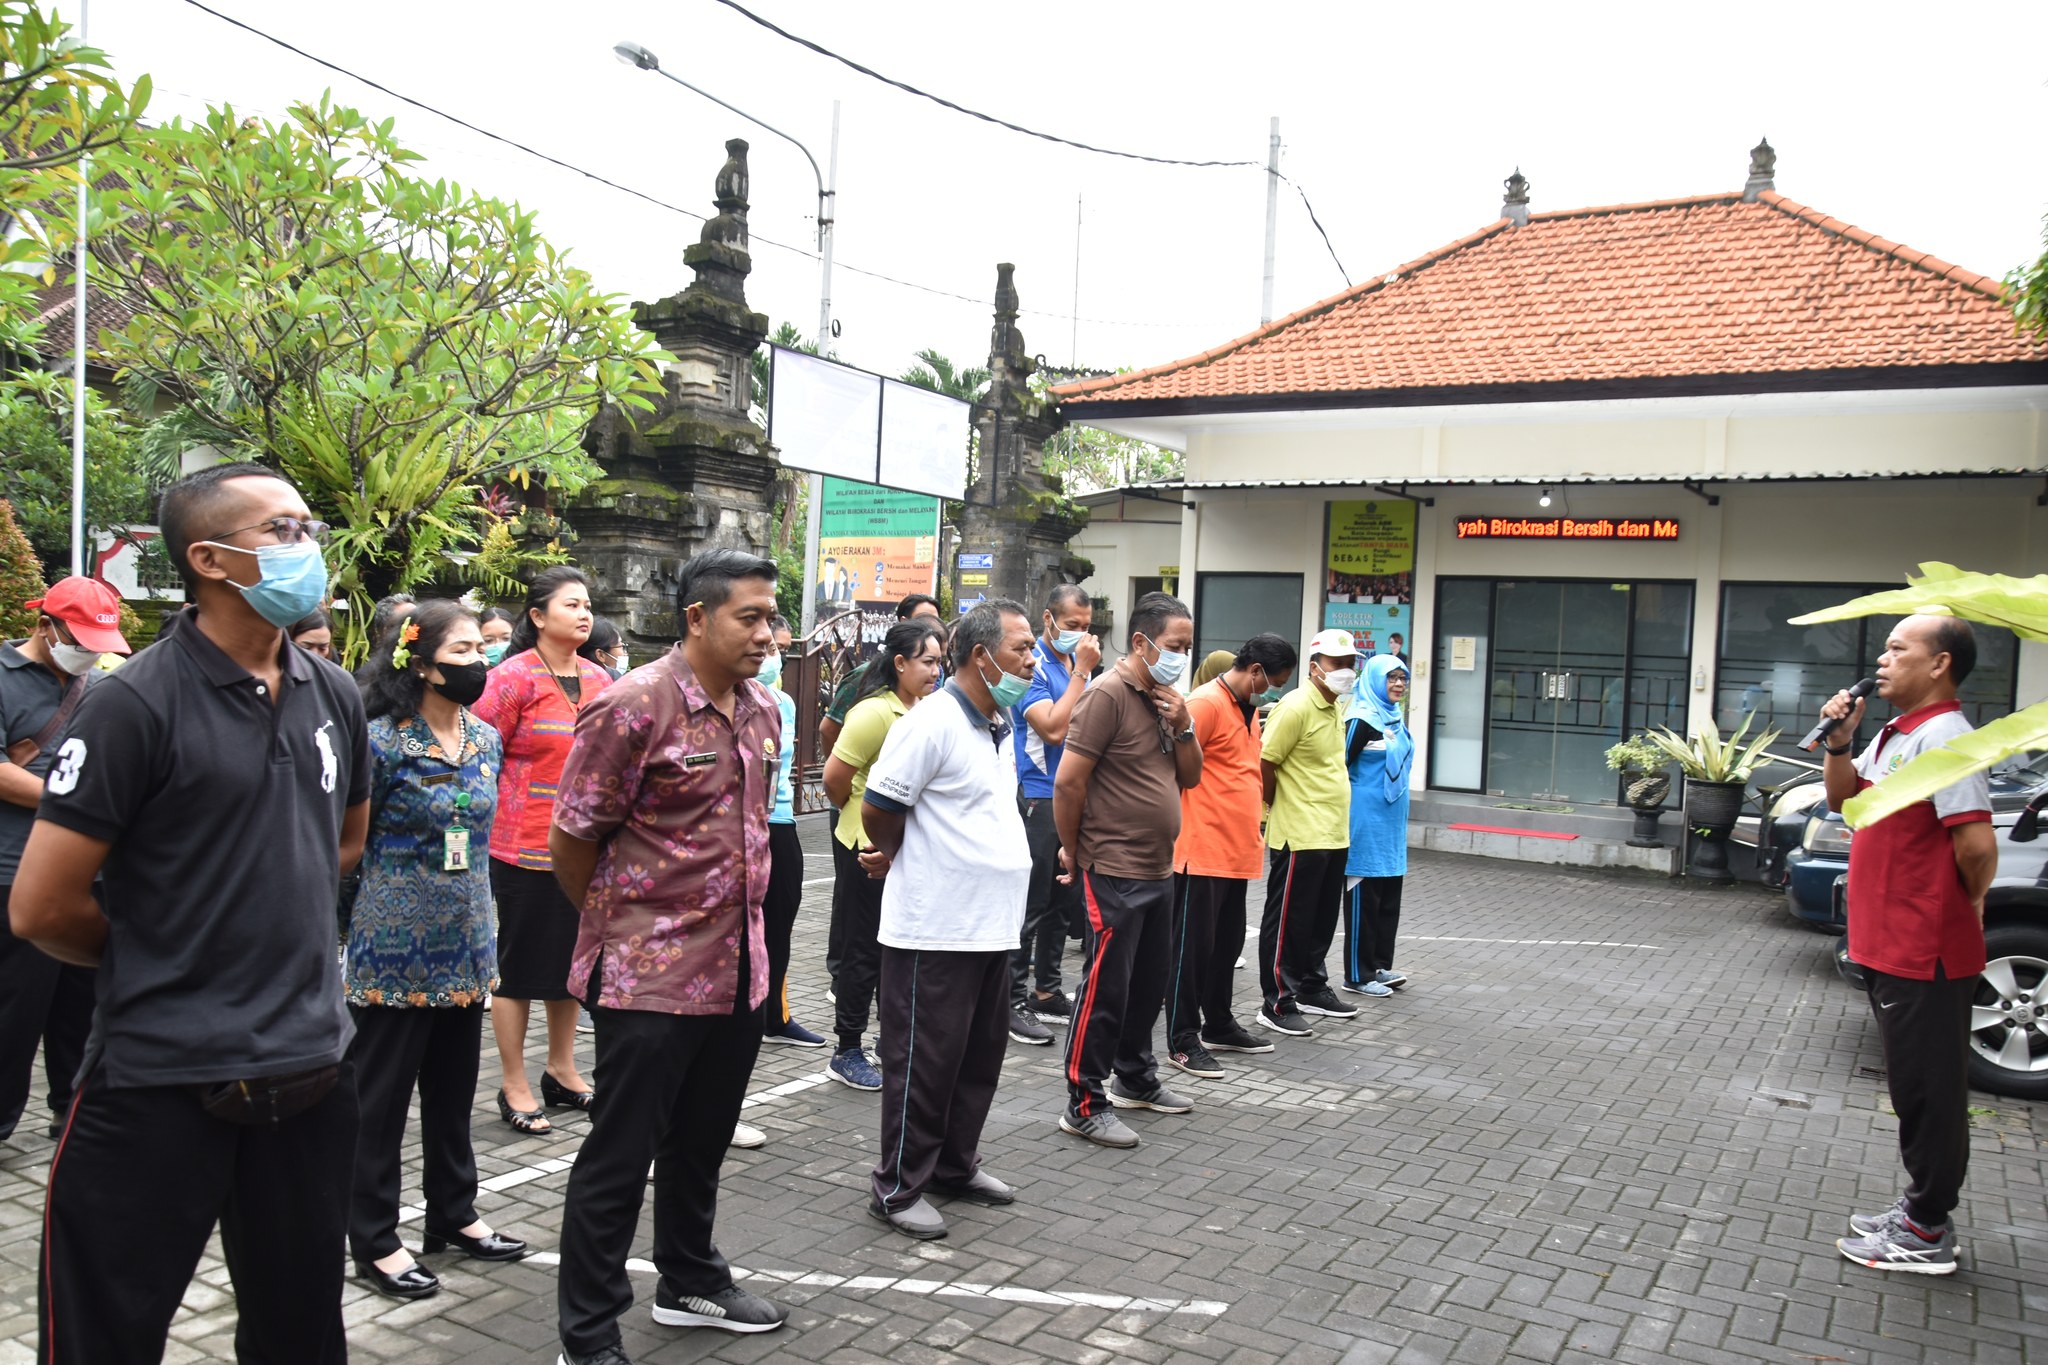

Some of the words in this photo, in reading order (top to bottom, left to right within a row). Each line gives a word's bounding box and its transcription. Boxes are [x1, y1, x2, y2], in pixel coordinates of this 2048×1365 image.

[1458, 520, 1486, 538] yah
[1490, 519, 1558, 536] Birokrasi
[1562, 520, 1613, 537] Bersih
[1617, 520, 1650, 537] dan
[48, 738, 88, 796] 3
[678, 1296, 727, 1318] PUMA
